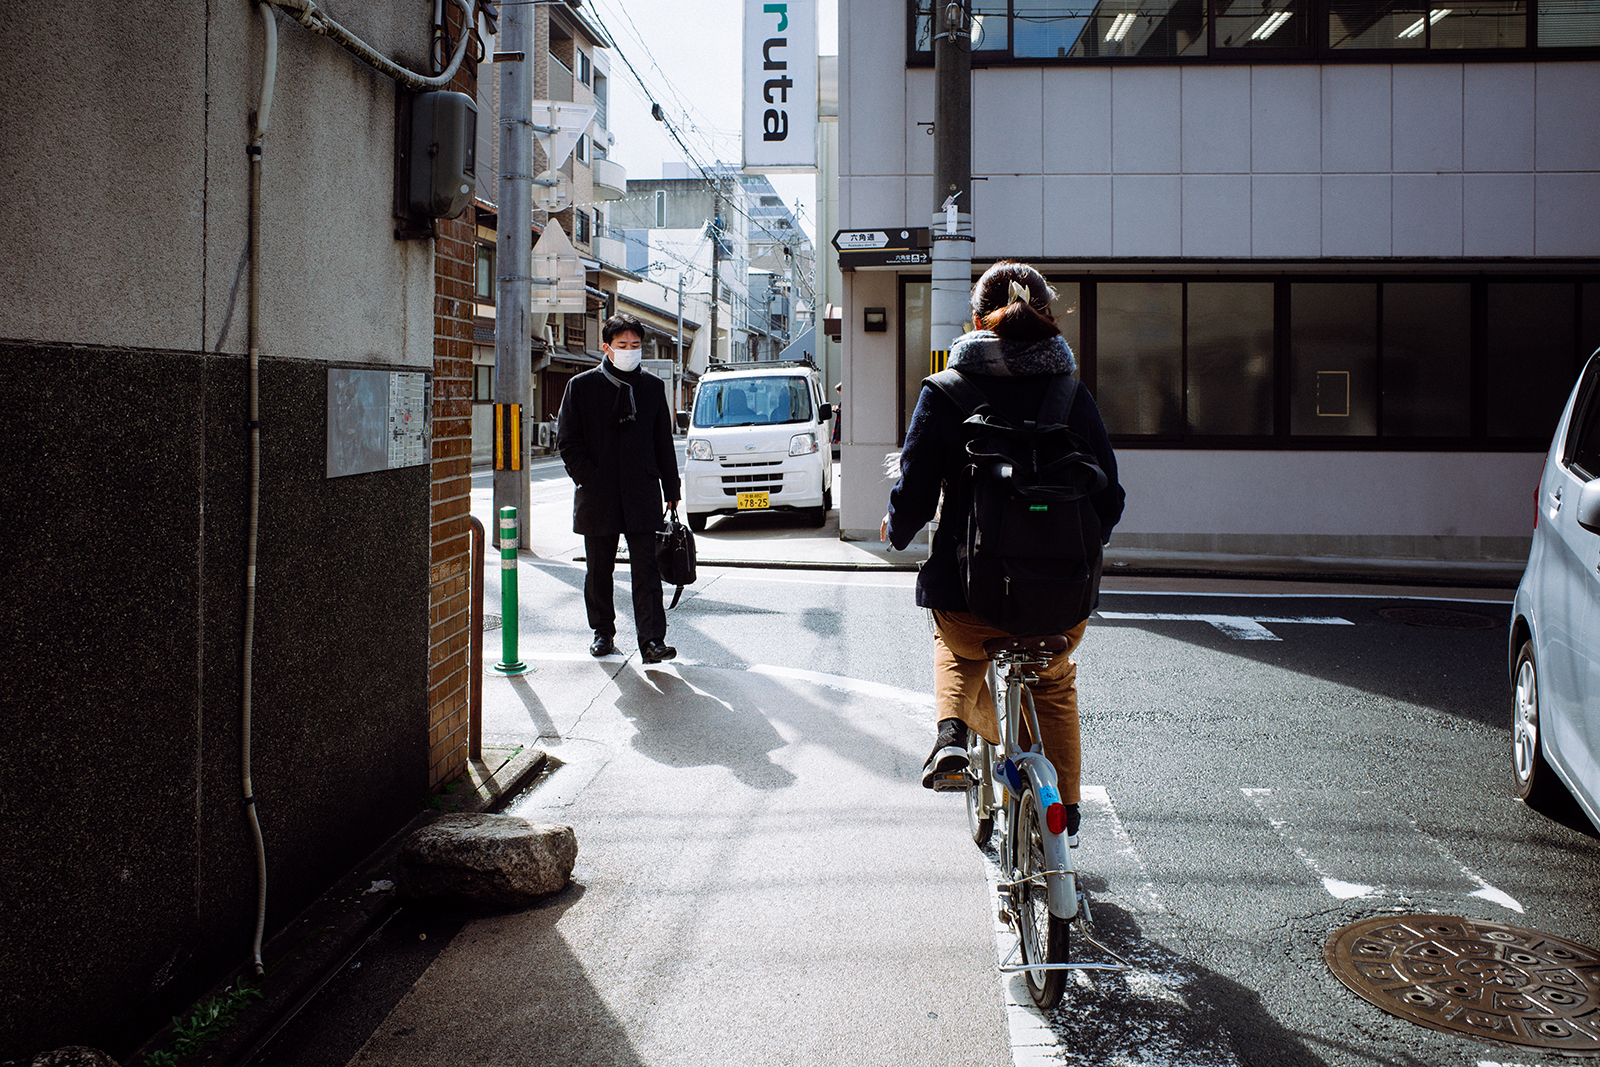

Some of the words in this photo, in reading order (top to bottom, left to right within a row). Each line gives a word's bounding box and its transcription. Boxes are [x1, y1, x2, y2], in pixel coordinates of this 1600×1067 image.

[762, 3, 794, 142] ruta
[850, 233, 875, 241] 六角通
[744, 499, 768, 508] 78-25
